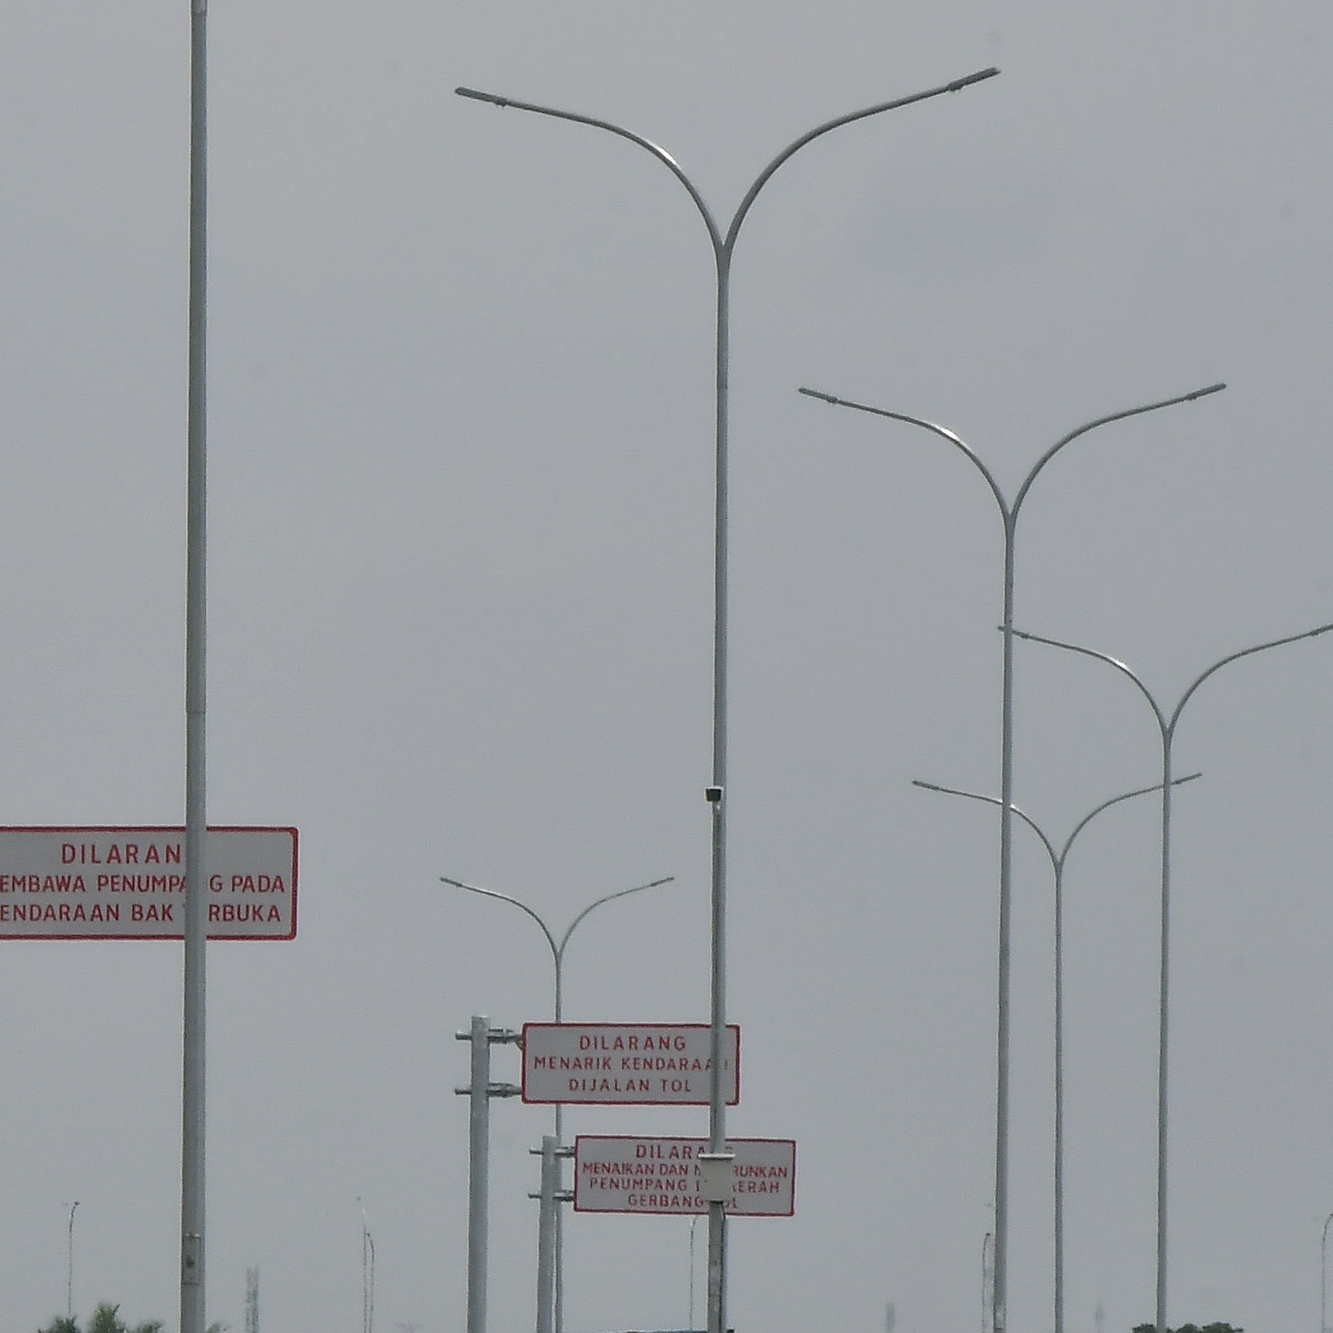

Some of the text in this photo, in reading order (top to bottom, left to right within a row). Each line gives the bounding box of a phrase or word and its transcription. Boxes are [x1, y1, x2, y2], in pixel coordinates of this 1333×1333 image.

[61, 843, 183, 865] DILARAN
[97, 874, 223, 893] PENUMPAG
[231, 874, 285, 893] PADA
[131, 903, 174, 922] BAK
[207, 903, 281, 922] RBUKA
[579, 1035, 686, 1051] DILARANG
[534, 1056, 612, 1070] MENARIK
[568, 1078, 692, 1092] DIJALAN TOL
[583, 1162, 655, 1175] MENAIKAN
[659, 1163, 689, 1176] DAN
[589, 1177, 688, 1191] PENUMPANG
[628, 1193, 704, 1208] GERBANG
